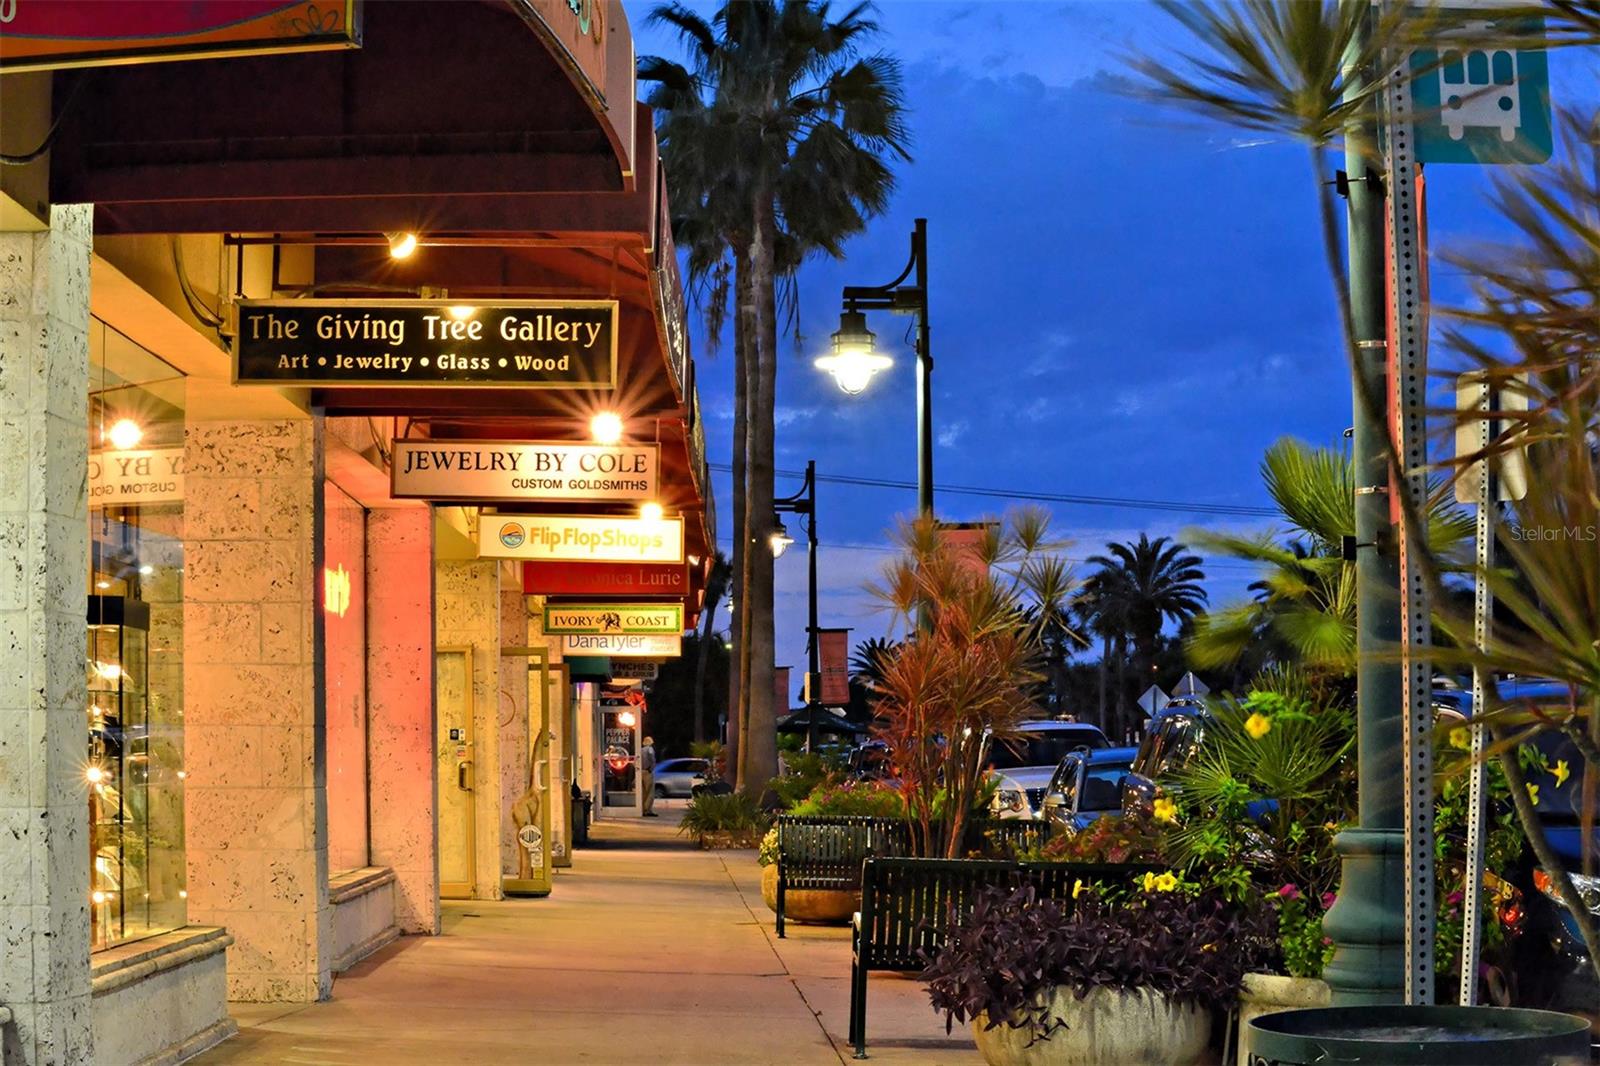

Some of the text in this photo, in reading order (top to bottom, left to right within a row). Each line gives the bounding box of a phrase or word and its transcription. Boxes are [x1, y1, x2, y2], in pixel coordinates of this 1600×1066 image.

[248, 313, 602, 348] The Giving Tree Gallery
[278, 353, 569, 373] Art Jewelry Glass Wood
[404, 451, 648, 474] JEWELRY BY COLE
[511, 478, 648, 491] CUSTOM GOLDSMITHS
[639, 568, 681, 585] Lurie
[554, 616, 669, 626] IVORY COAST
[610, 663, 654, 671] YNCHES
